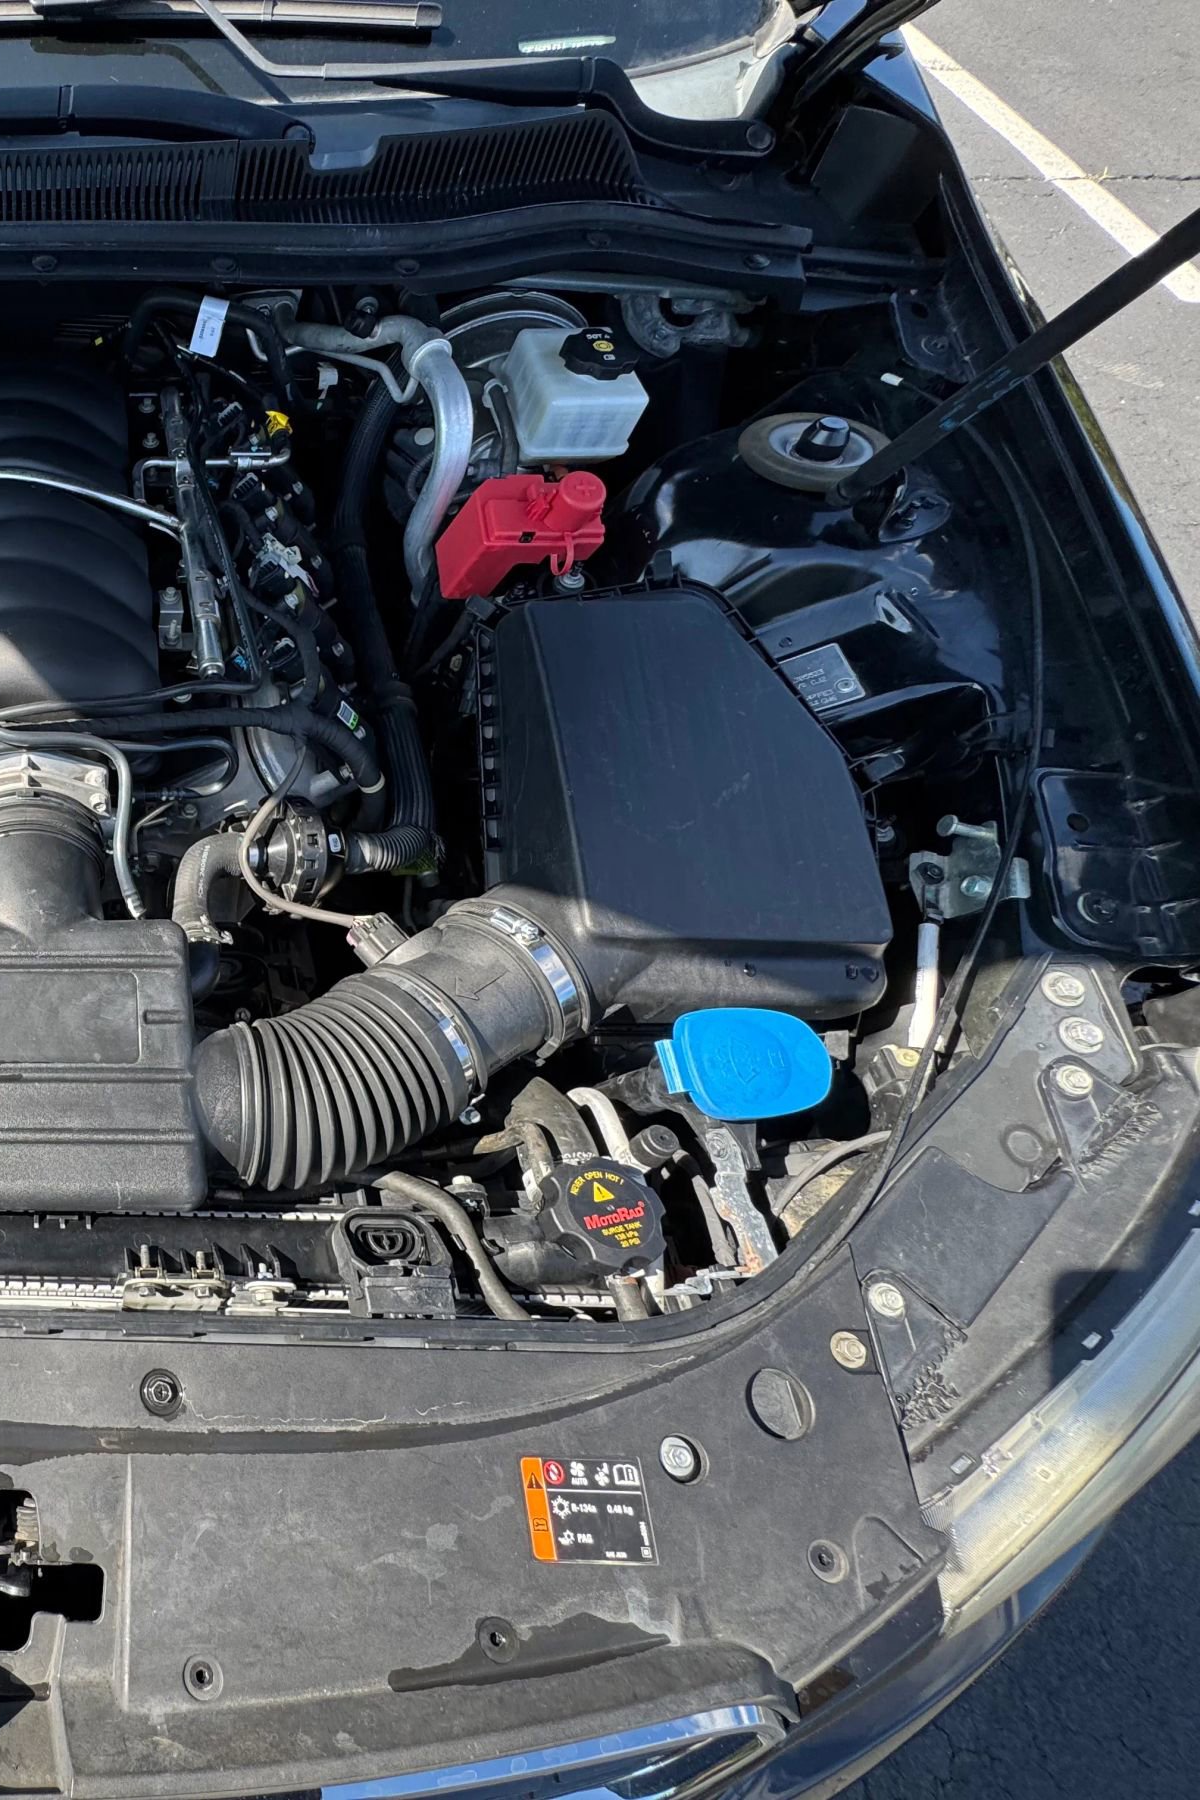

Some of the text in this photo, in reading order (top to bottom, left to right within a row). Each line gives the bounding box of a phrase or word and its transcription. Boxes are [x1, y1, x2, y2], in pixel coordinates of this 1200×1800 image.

[570, 1176, 586, 1196] NEVER
[584, 1171, 603, 1180] OPEN
[601, 1221, 642, 1236] SURGE TANK
[628, 1238, 641, 1246] PSI
[571, 1477, 588, 1486] AUTO
[570, 1502, 597, 1513] R-134a
[622, 1504, 634, 1516] kg
[577, 1533, 594, 1544] PAG
